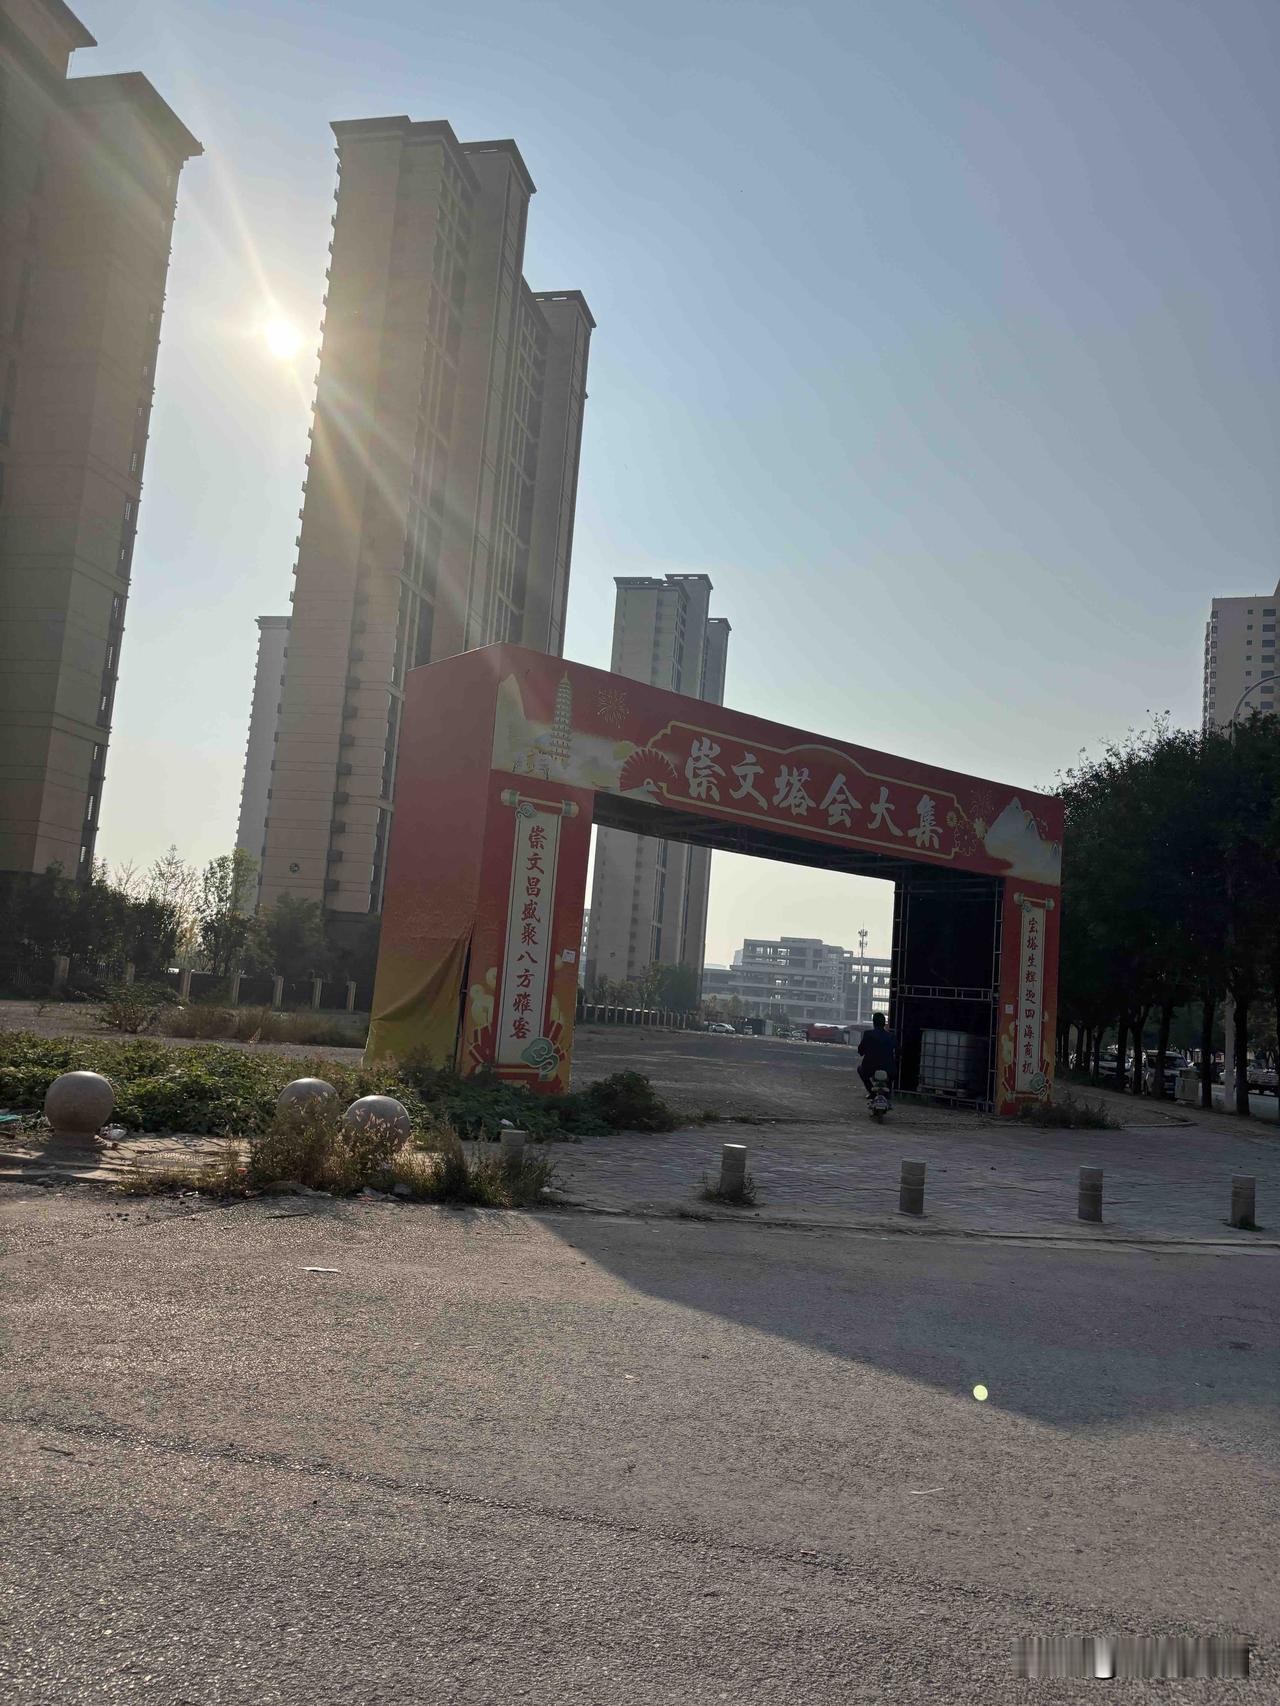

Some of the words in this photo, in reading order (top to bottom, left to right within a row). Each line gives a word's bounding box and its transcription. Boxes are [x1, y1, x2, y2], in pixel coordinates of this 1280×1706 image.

[684, 736, 944, 849] 崇文塔会大集
[509, 825, 548, 1040] 崇文昌盛聚八方雅客
